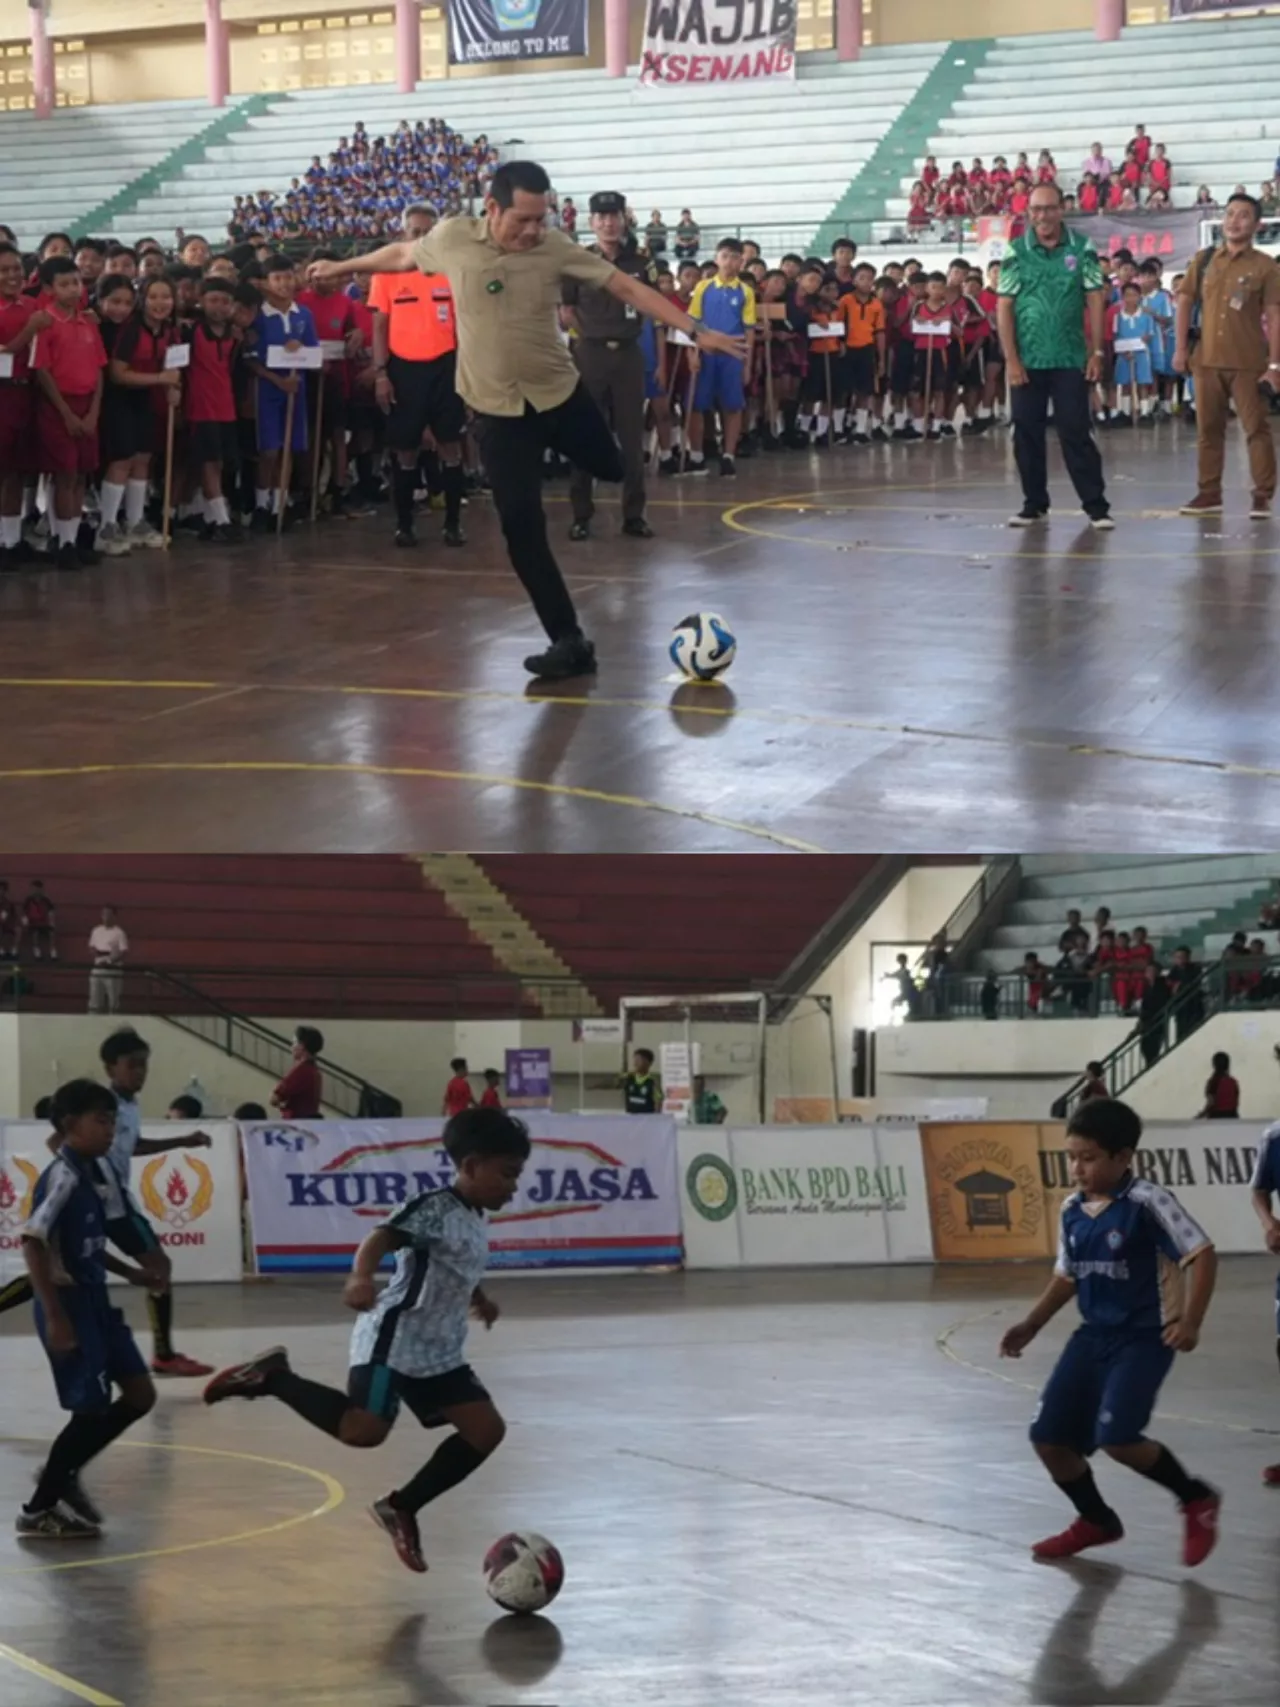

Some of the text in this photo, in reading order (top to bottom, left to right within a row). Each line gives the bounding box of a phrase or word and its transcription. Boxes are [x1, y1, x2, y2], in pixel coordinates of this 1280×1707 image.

[648, 0, 792, 44] WAJIB
[524, 38, 544, 54] TO
[548, 35, 570, 52] ME
[741, 1165, 907, 1200] BANK BPD BALI
[1135, 1148, 1196, 1187] RYA
[286, 1167, 659, 1206] KURN JASA
[157, 1232, 205, 1246] KONI
